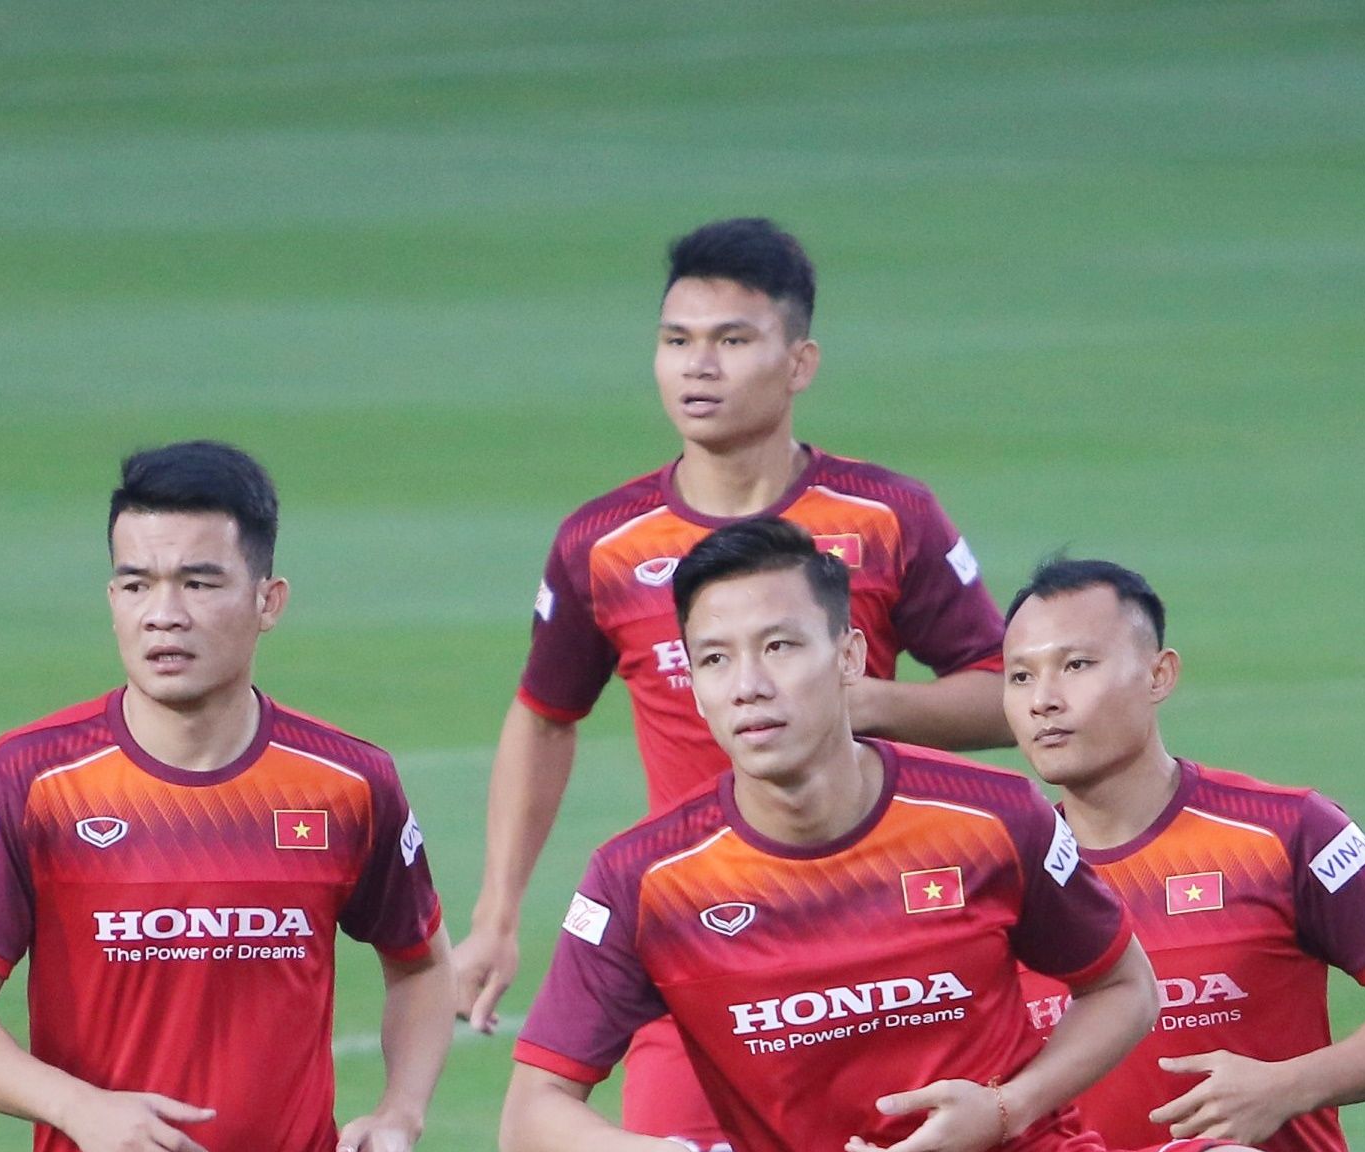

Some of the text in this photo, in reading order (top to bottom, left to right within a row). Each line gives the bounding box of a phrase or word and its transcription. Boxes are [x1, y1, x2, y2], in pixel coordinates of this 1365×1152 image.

[666, 675, 691, 689] Th
[93, 907, 313, 941] HONDA
[103, 944, 306, 962] The Power of Dreams
[728, 971, 973, 1035] HONDA
[744, 1007, 965, 1055] The Power of Dreams
[1161, 1008, 1241, 1031] Dreams
